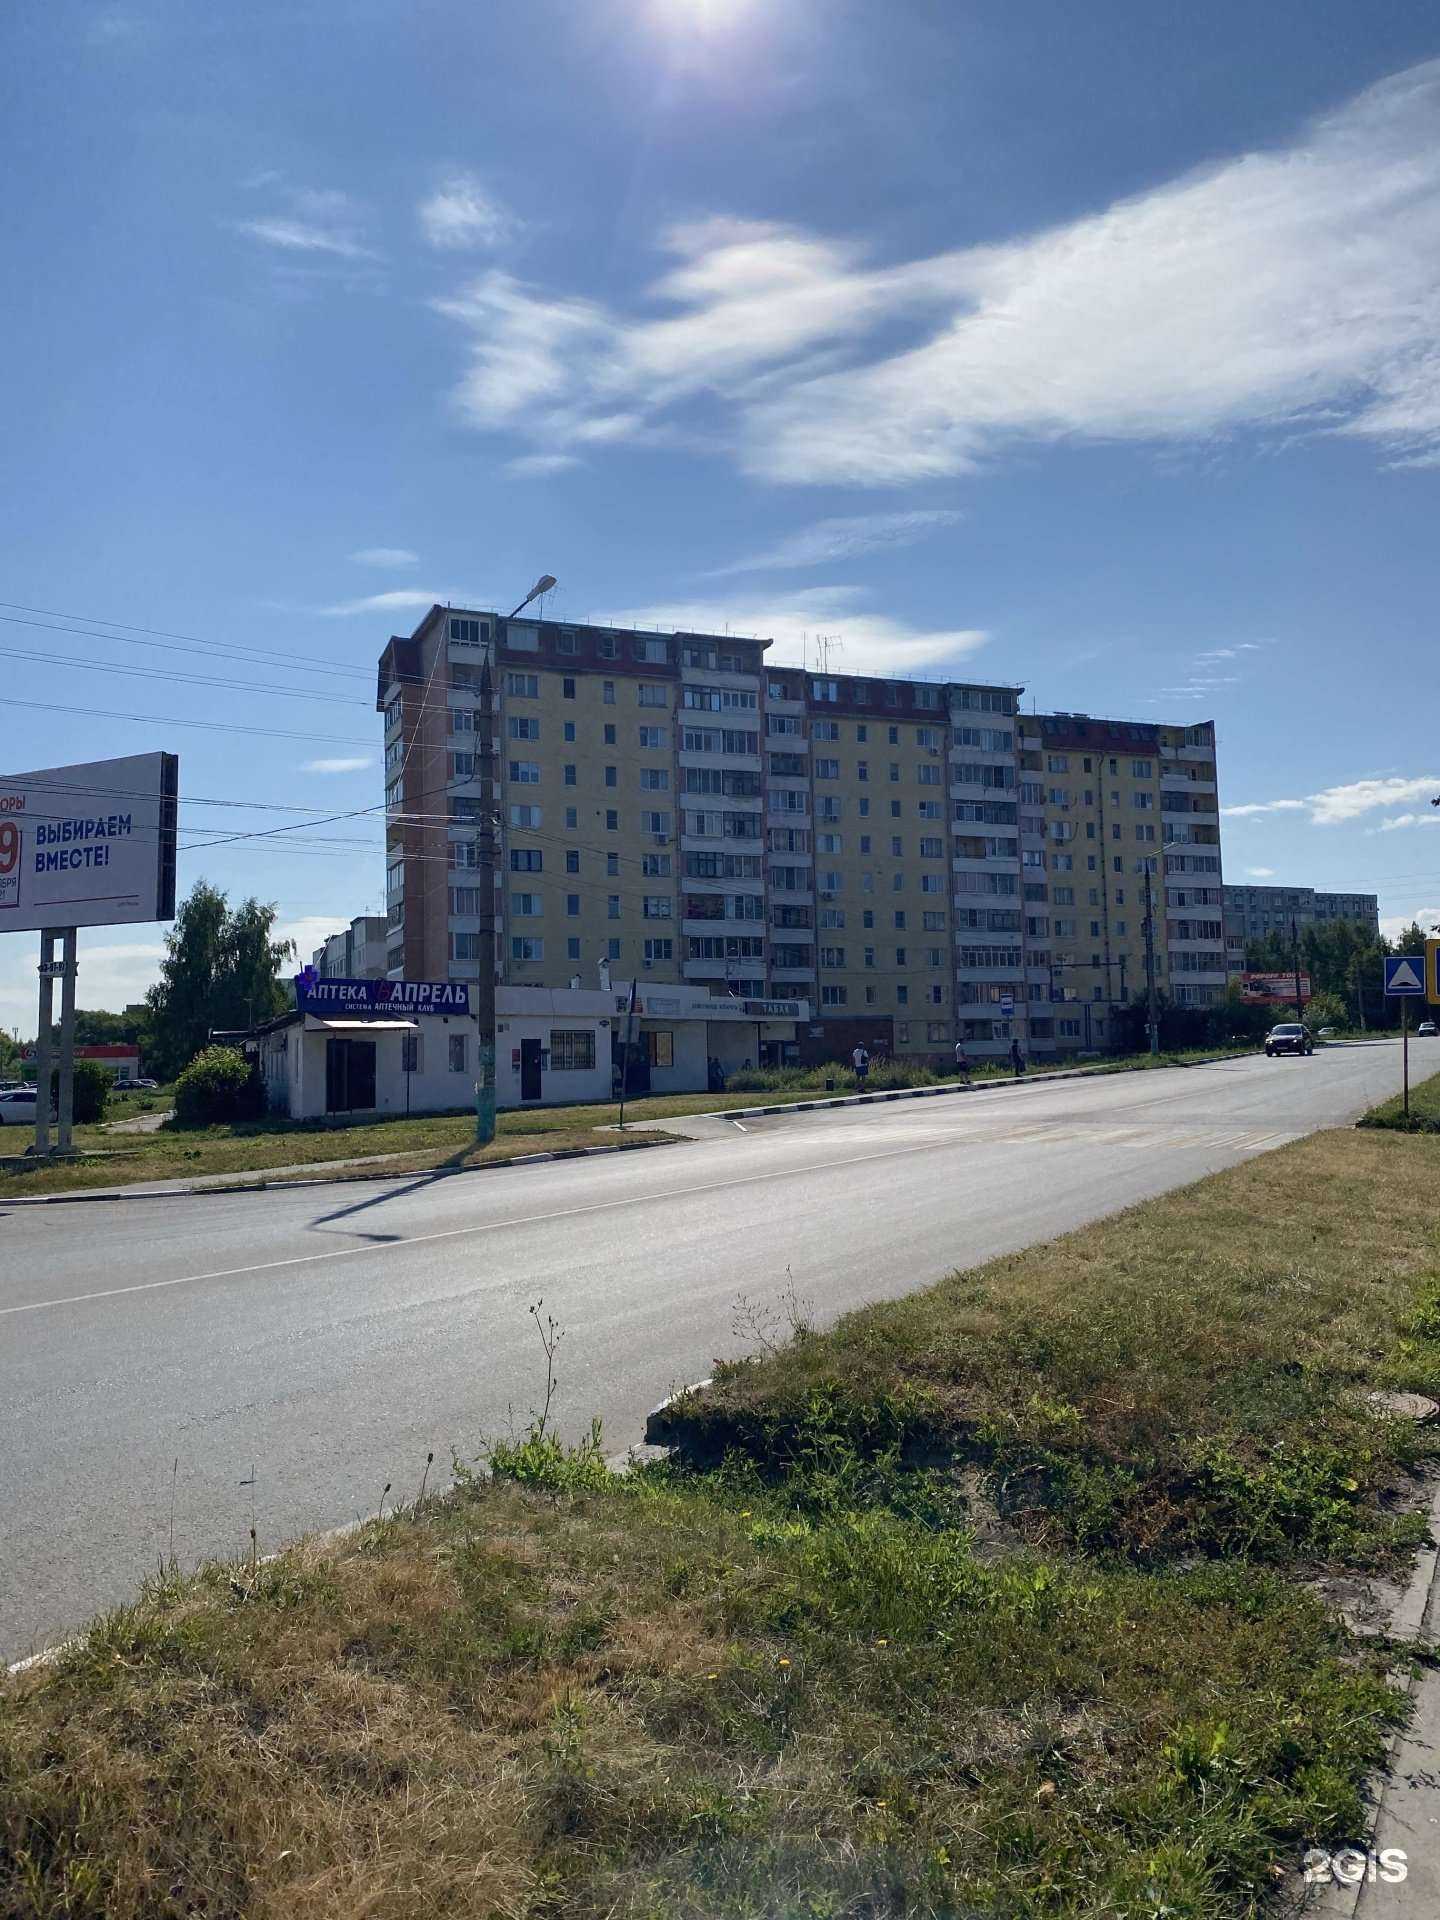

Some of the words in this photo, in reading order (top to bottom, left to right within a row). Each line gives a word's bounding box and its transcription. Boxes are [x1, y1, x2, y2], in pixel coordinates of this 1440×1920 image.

[36, 814, 132, 846] ВЫБИРАЕМ
[35, 845, 110, 873] ВМЕСТЕ!
[307, 984, 368, 1000] АПТЕКА
[390, 983, 466, 1004] АПРЕЛЬ
[374, 1002, 414, 1012] АПТЕЧНЫЙ
[418, 1004, 435, 1012] КЛУБ
